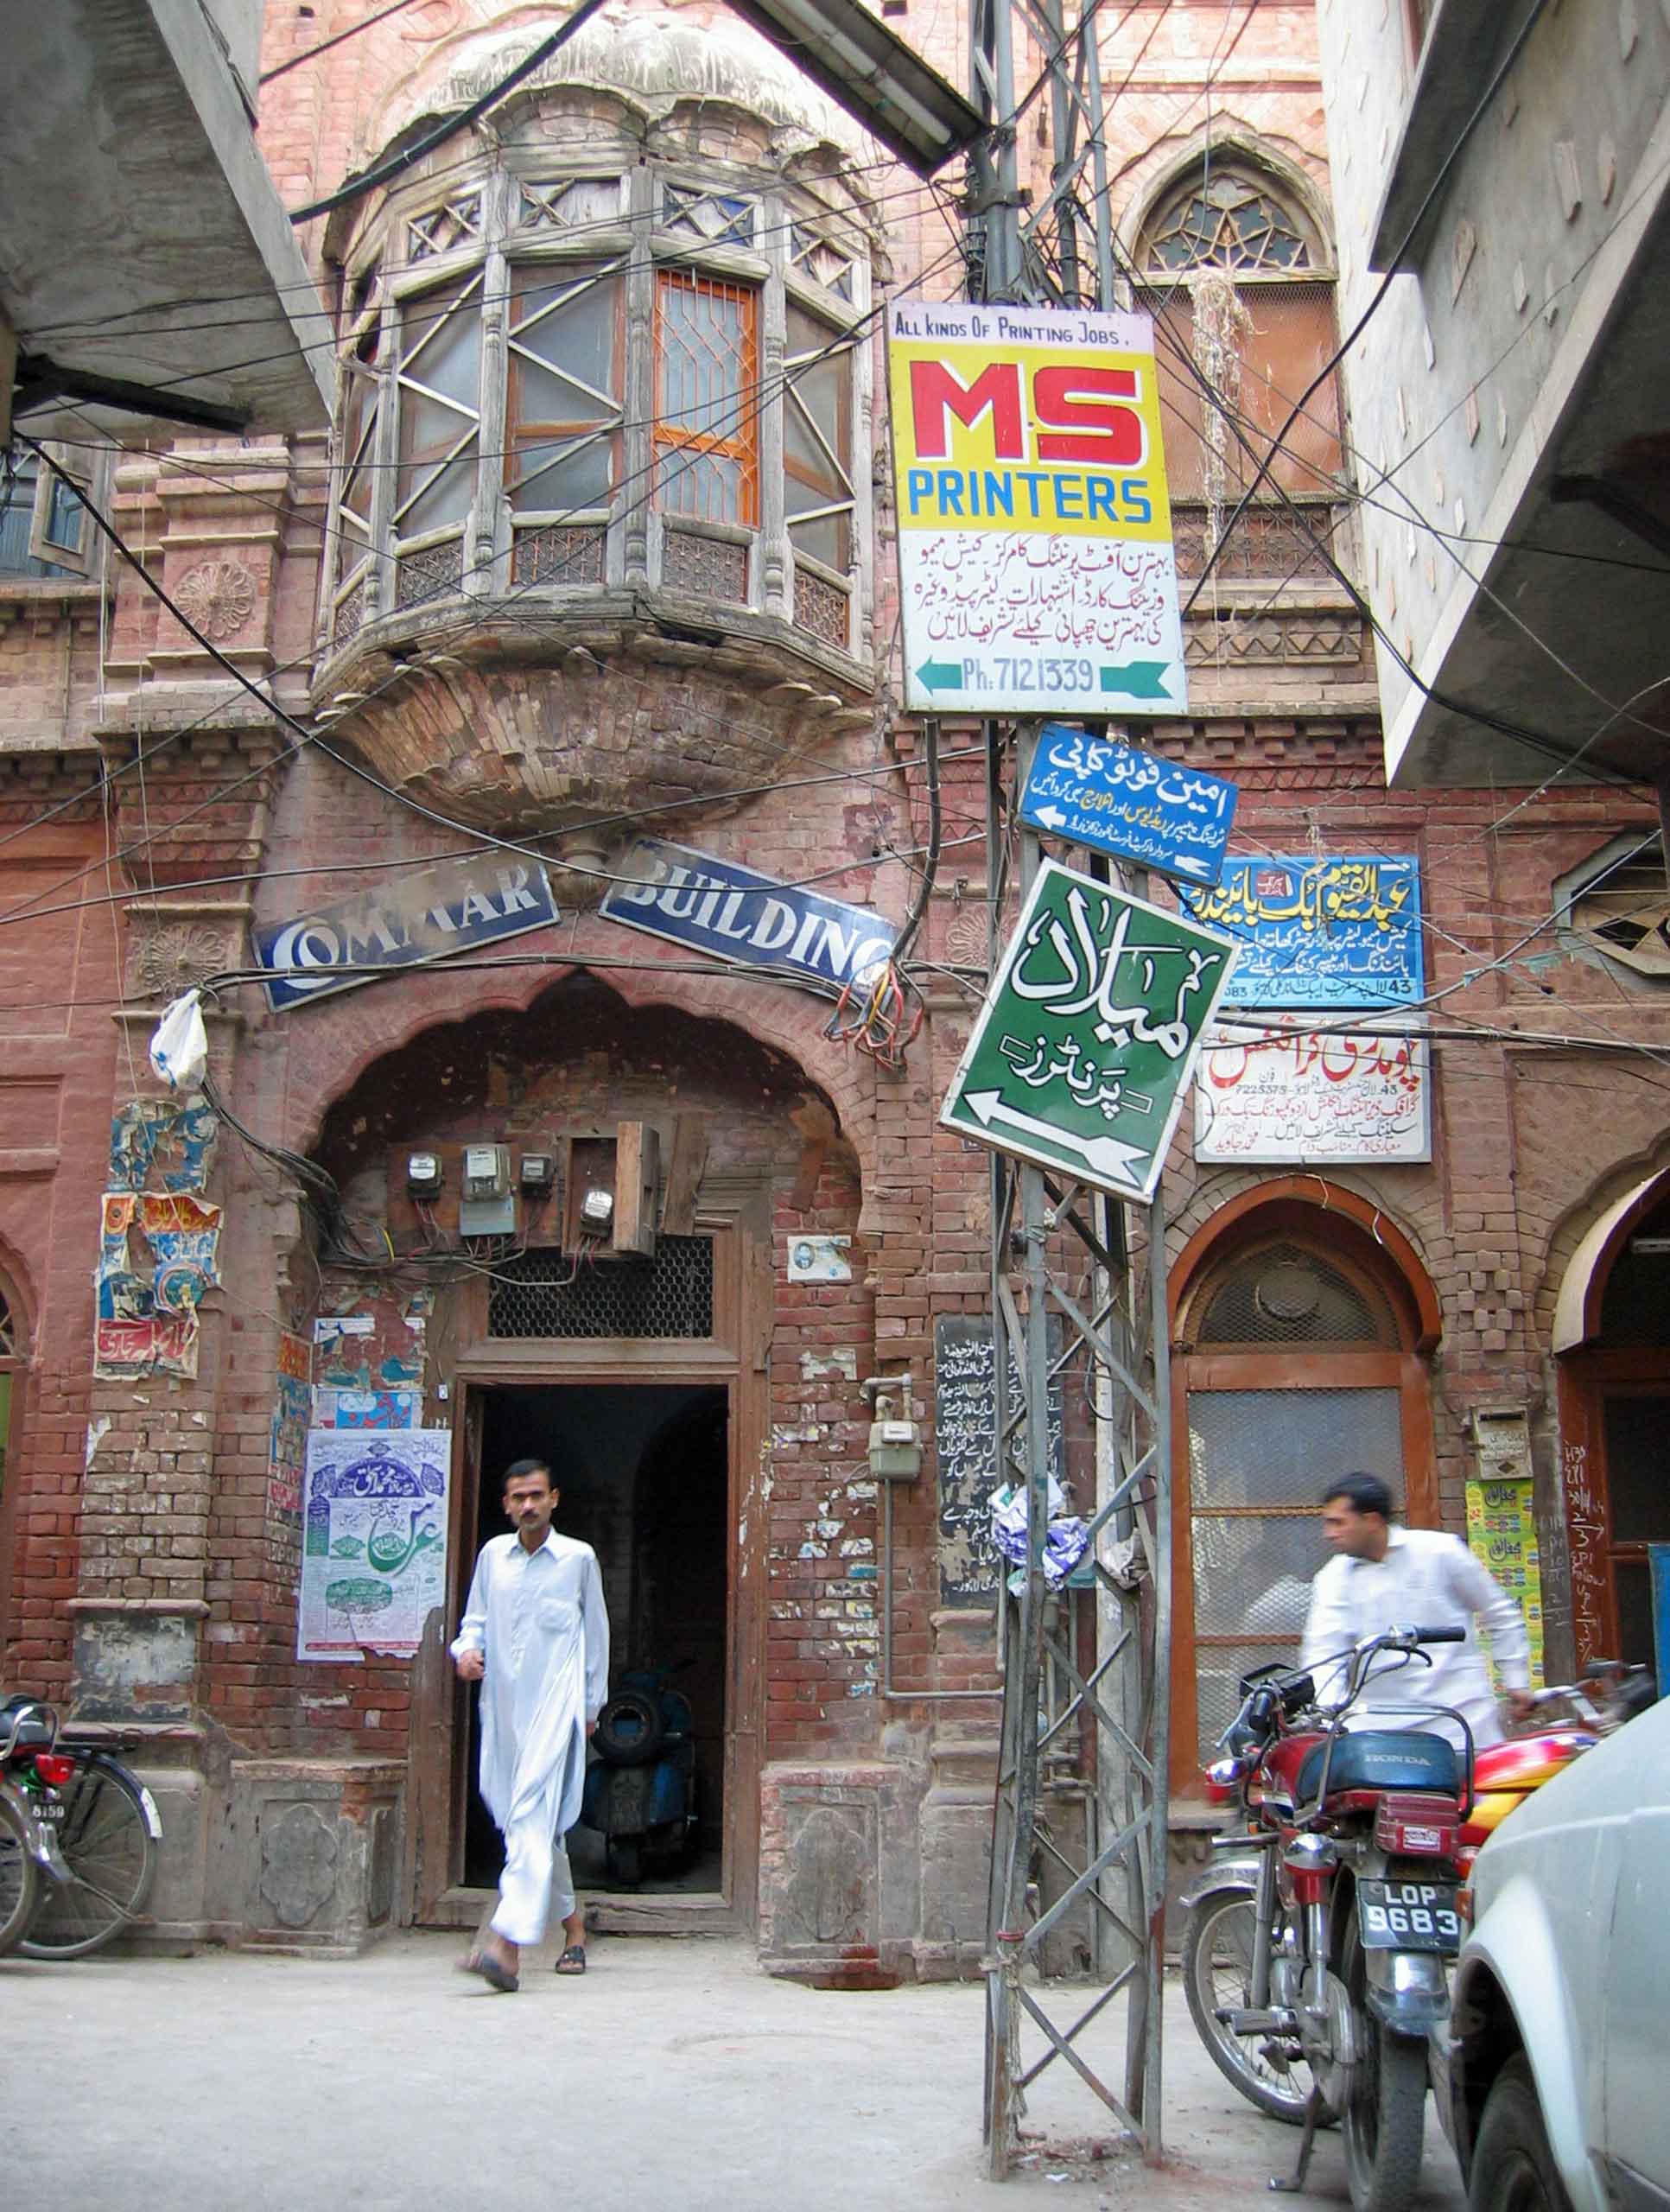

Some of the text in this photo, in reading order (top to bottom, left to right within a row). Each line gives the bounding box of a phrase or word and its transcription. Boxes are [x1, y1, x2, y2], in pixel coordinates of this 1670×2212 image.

[895, 315, 921, 338] ALL
[999, 315, 1073, 343] PRINTING
[908, 469, 1152, 524] PRINTERS
[1121, 550, 1172, 590] بہترین
[968, 607, 1015, 646] تشریف
[1096, 615, 1146, 651] بہترین
[1146, 613, 1165, 645] کی
[1049, 737, 1228, 817] امین فوٹو کاپی
[1316, 862, 1410, 931] عبدالقیوم
[619, 860, 894, 984] BUILDING
[1010, 885, 1221, 1059] میلاد
[1389, 979, 1412, 995] 43
[1009, 1034, 1122, 1121] پرنٹرز
[1385, 1885, 1436, 1904] LOP
[1368, 1906, 1459, 1936] 9683
